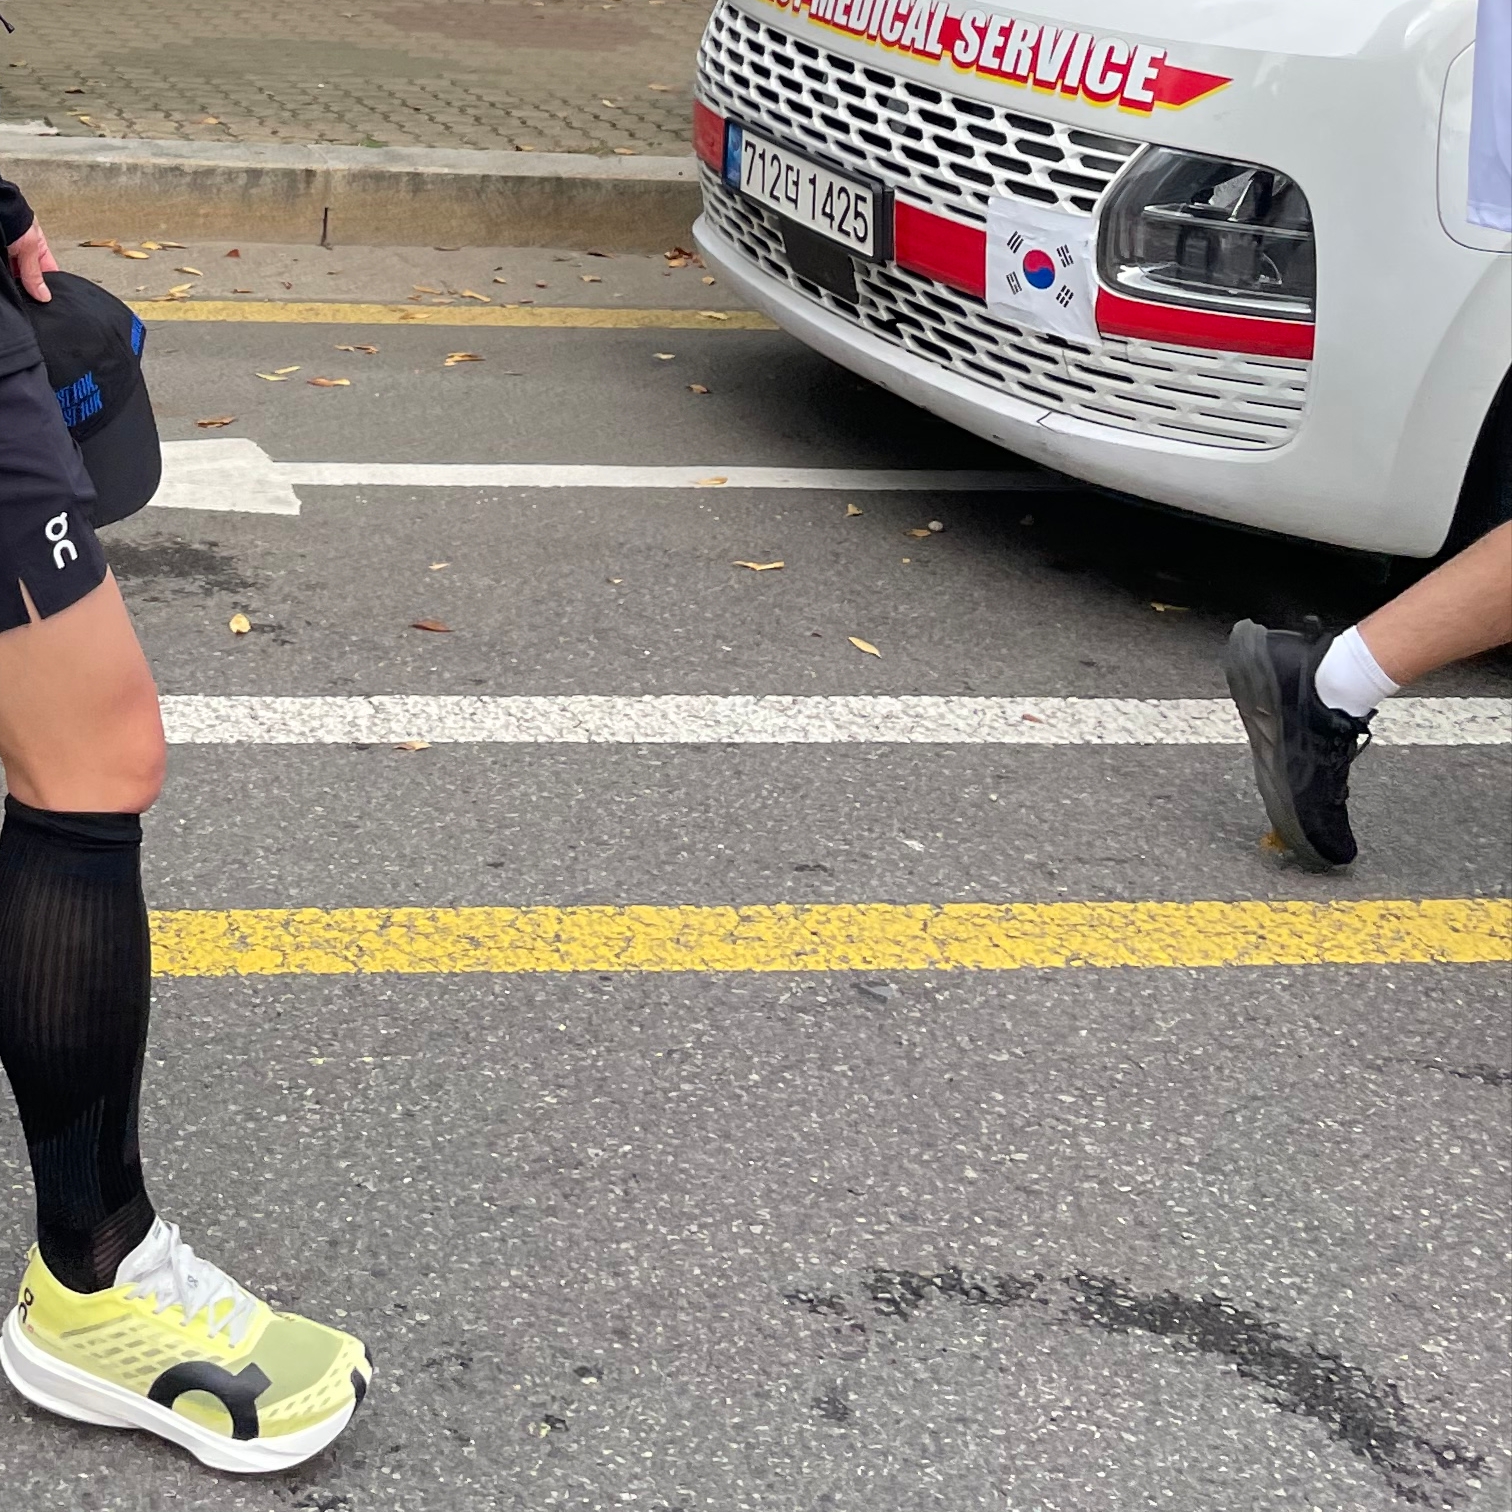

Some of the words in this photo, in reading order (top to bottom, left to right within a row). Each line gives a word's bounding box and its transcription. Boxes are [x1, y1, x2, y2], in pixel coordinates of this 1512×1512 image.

[952, 7, 1167, 104] SERVICE
[744, 139, 801, 211] 712더
[808, 172, 869, 244] 1425
